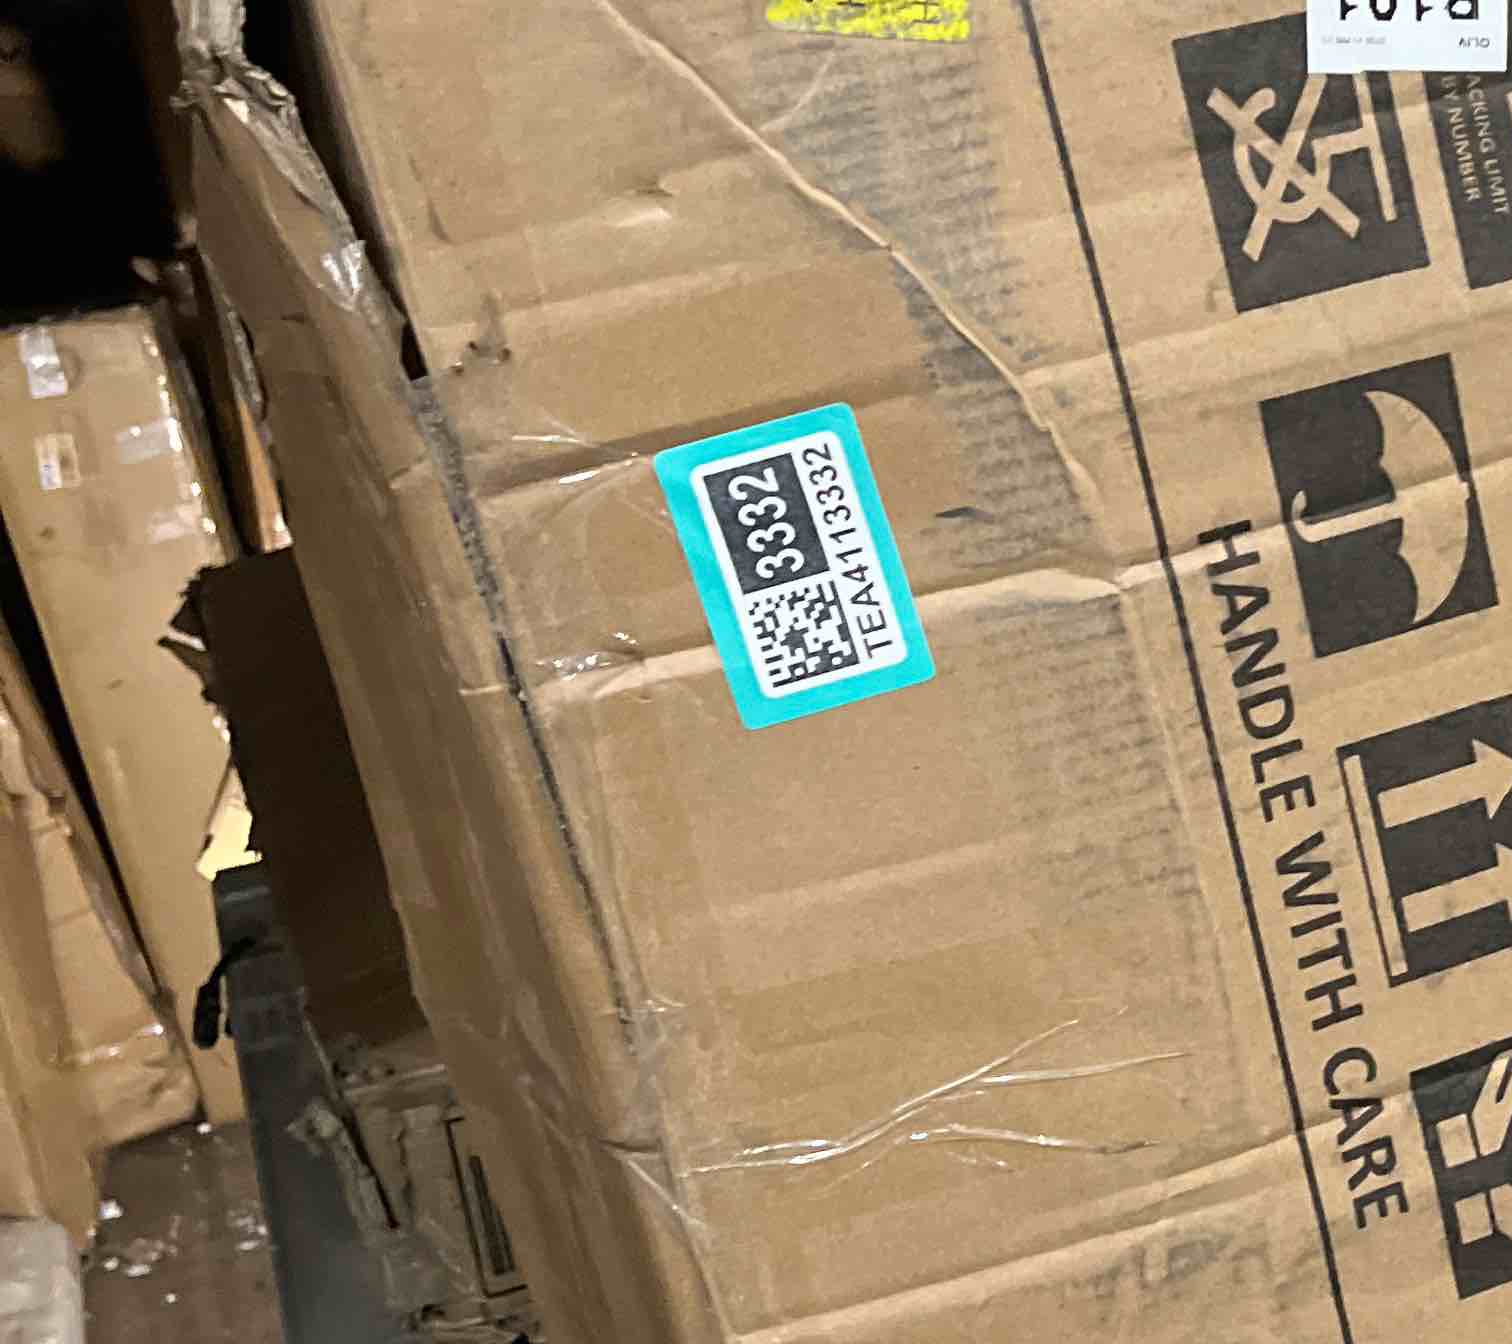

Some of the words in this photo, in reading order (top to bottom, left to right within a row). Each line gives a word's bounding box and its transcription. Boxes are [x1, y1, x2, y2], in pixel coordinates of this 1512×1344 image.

[1449, 103, 1481, 201] NUMBER
[728, 467, 804, 579] 3332
[802, 443, 893, 658] TEA4113332
[1199, 520, 1316, 822] HANDLE
[1275, 831, 1364, 1031] WITH
[1322, 1047, 1409, 1229] CARE
